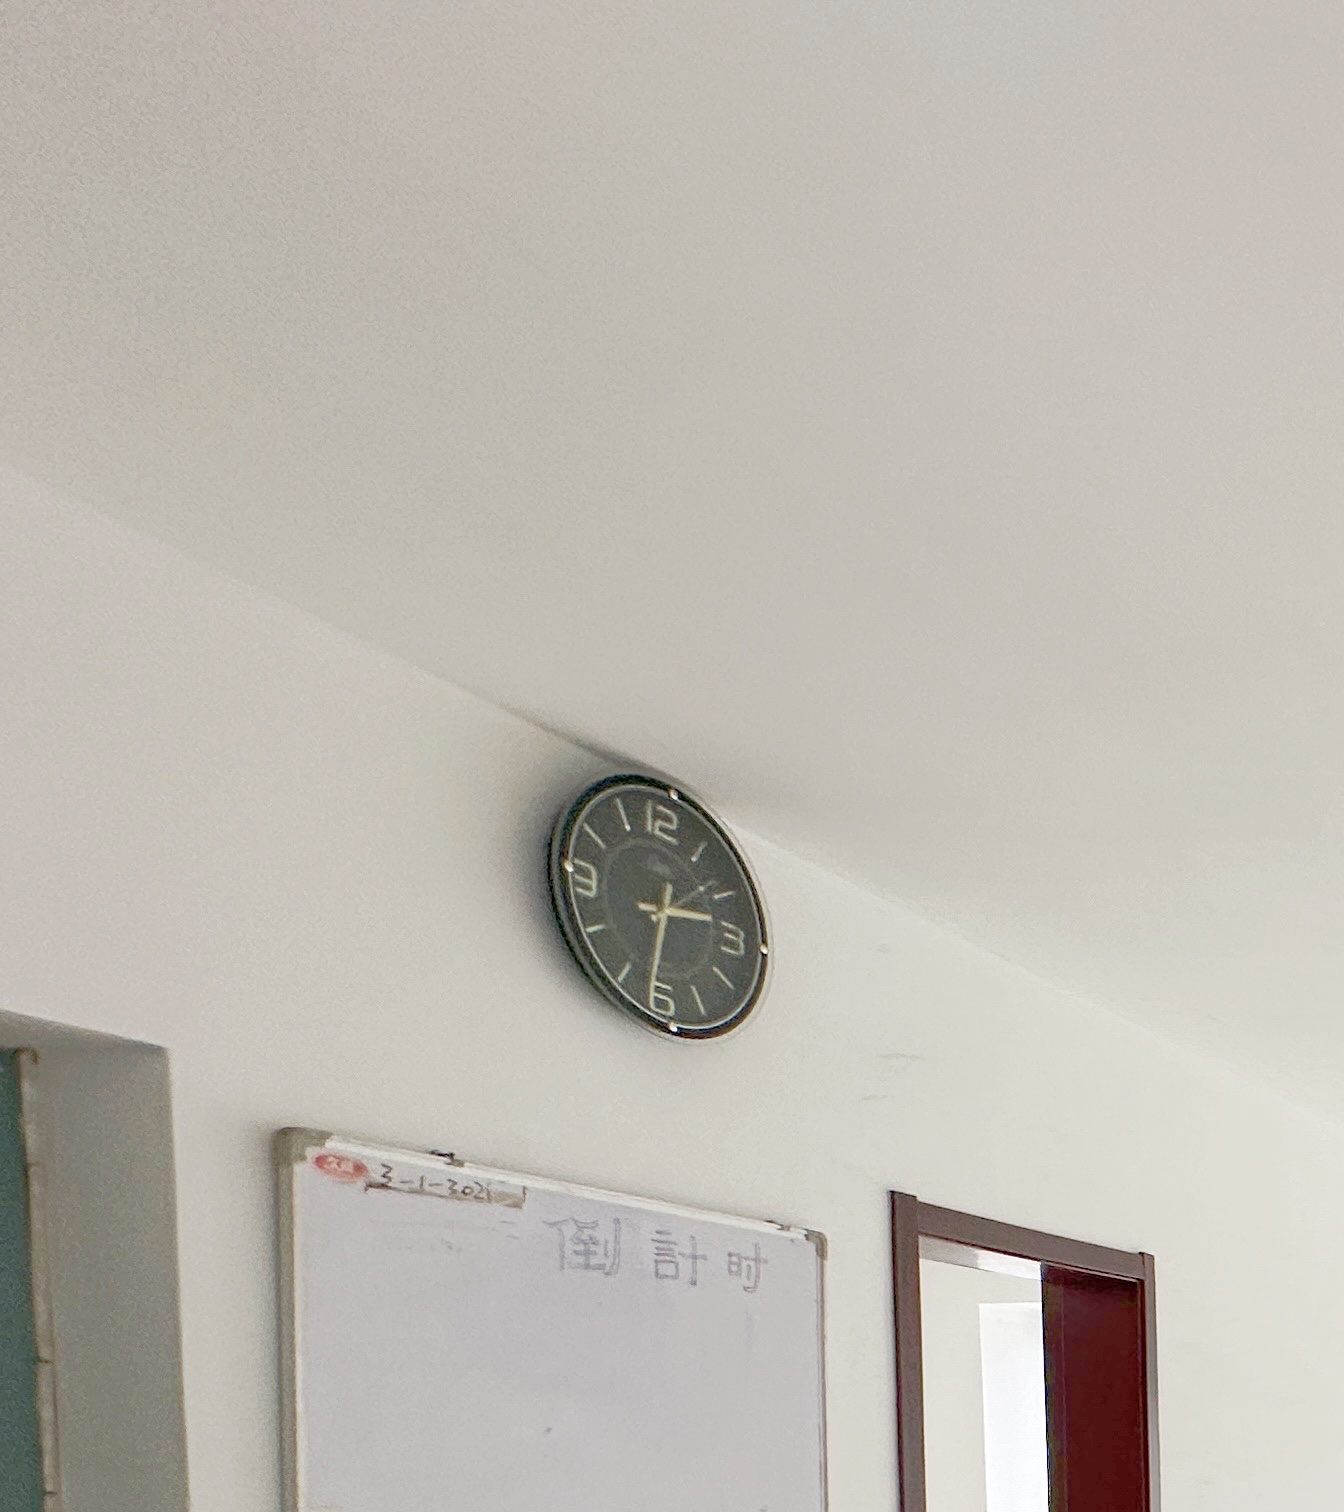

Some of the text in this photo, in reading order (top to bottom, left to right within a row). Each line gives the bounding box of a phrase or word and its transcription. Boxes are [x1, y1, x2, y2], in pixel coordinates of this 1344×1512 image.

[646, 799, 679, 846] 12
[719, 920, 745, 956] 3
[649, 980, 675, 1017] 6
